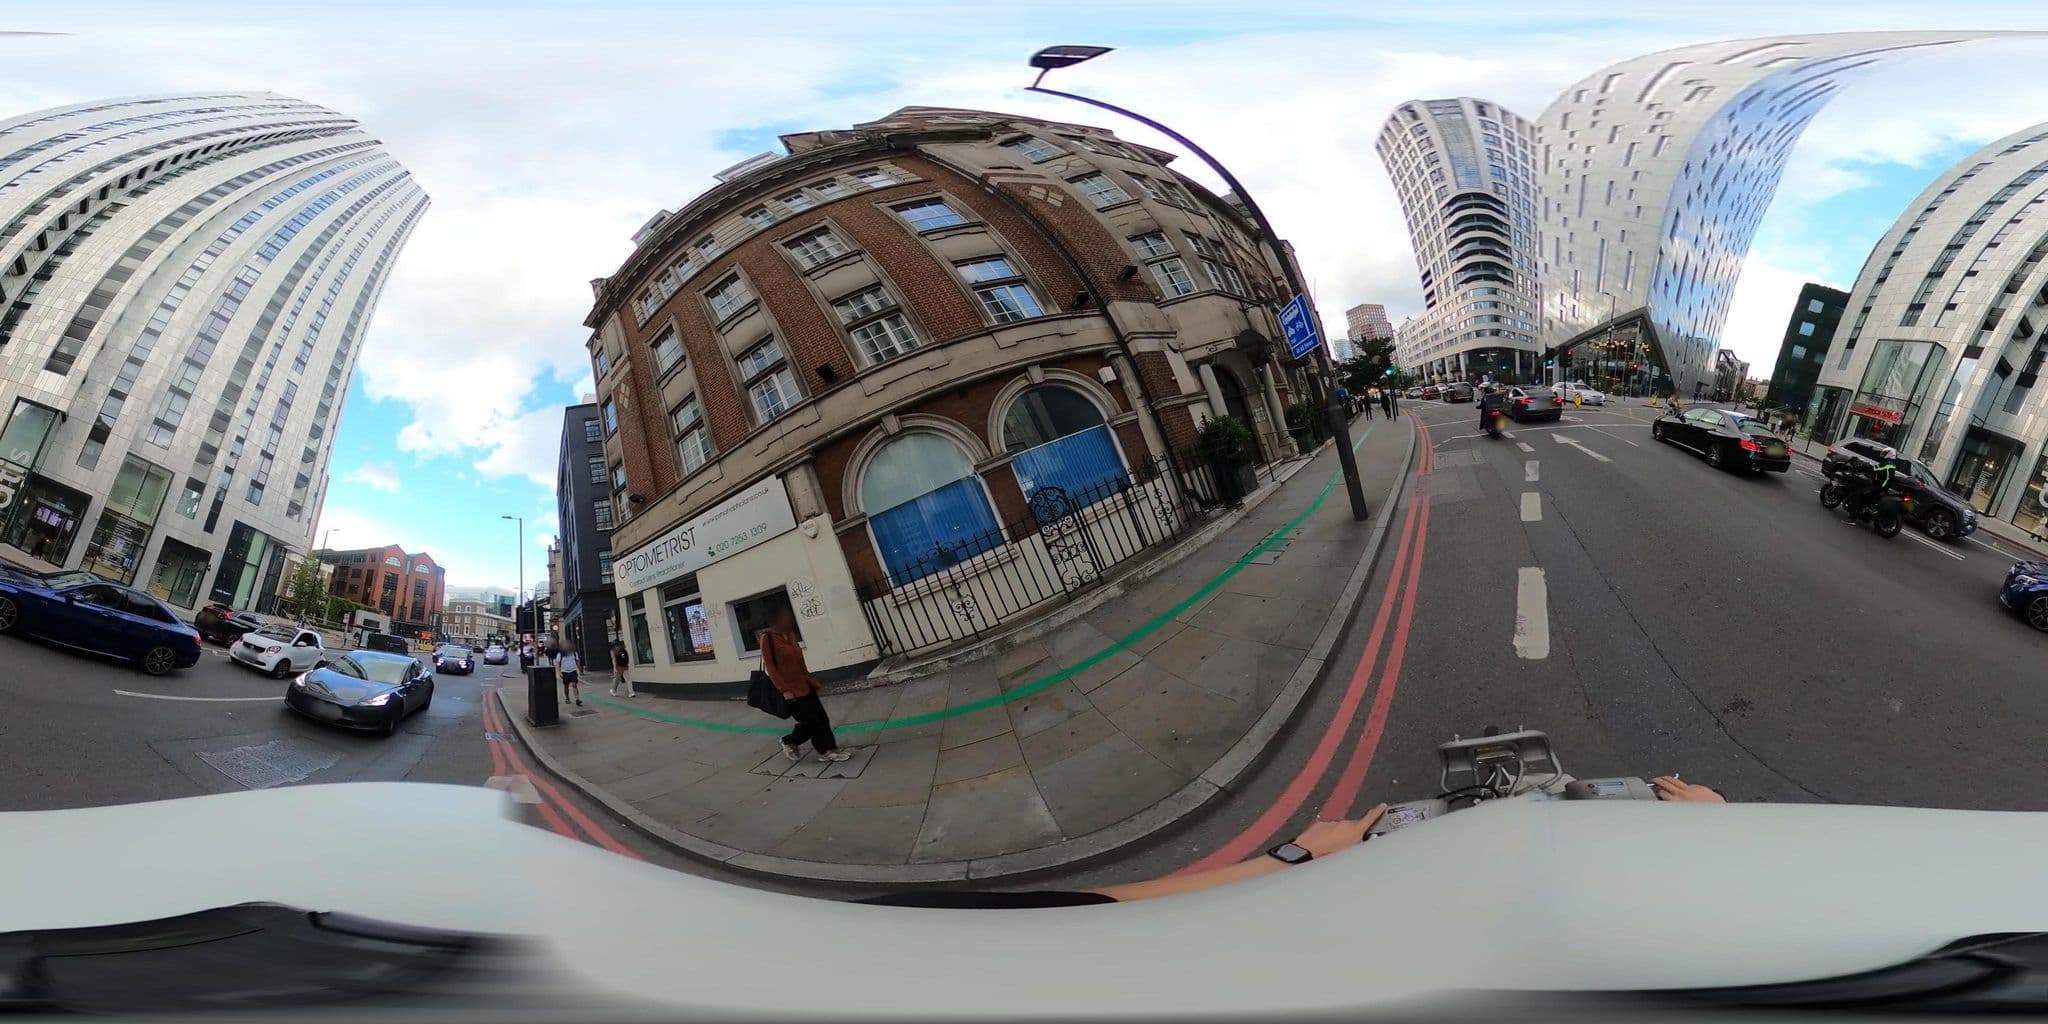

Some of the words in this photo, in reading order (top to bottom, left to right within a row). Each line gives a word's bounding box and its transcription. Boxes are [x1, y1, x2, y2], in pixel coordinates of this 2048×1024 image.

[618, 526, 697, 579] OPTOMETRIST
[716, 540, 730, 553] 020
[731, 531, 748, 546] 7253
[750, 522, 767, 537] 1309
